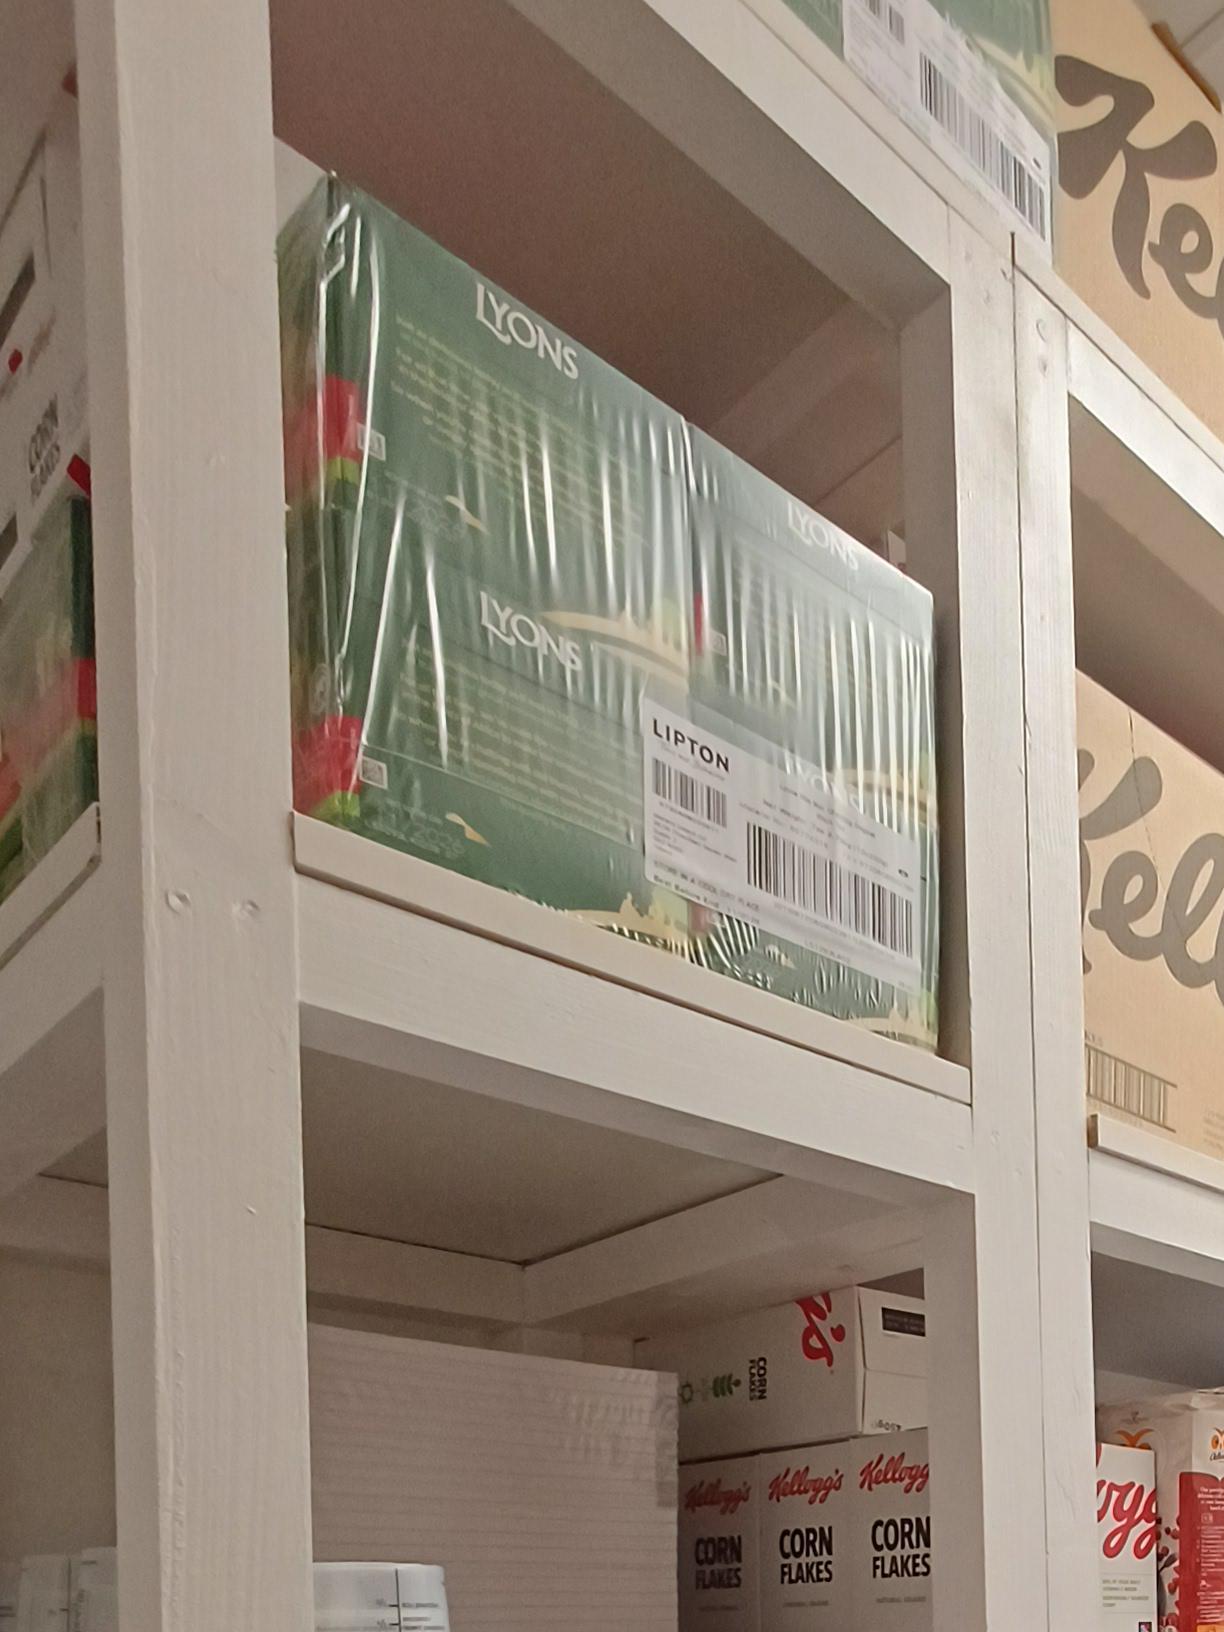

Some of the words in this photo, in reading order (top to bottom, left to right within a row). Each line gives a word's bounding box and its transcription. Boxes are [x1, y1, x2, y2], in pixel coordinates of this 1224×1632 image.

[476, 282, 579, 379] LYONS
[788, 500, 859, 571] LYONS
[480, 591, 583, 671] LYONS
[653, 718, 730, 773] LIPTON
[756, 1356, 767, 1401] CORN
[768, 1465, 844, 1505] Kellogg's
[694, 1535, 742, 1566] CORN
[779, 1526, 833, 1560] CORN
[871, 1516, 931, 1551] CORN
[695, 1568, 742, 1590] FLAKES
[780, 1561, 833, 1585] FLAKES
[872, 1553, 931, 1579] FLAKES
